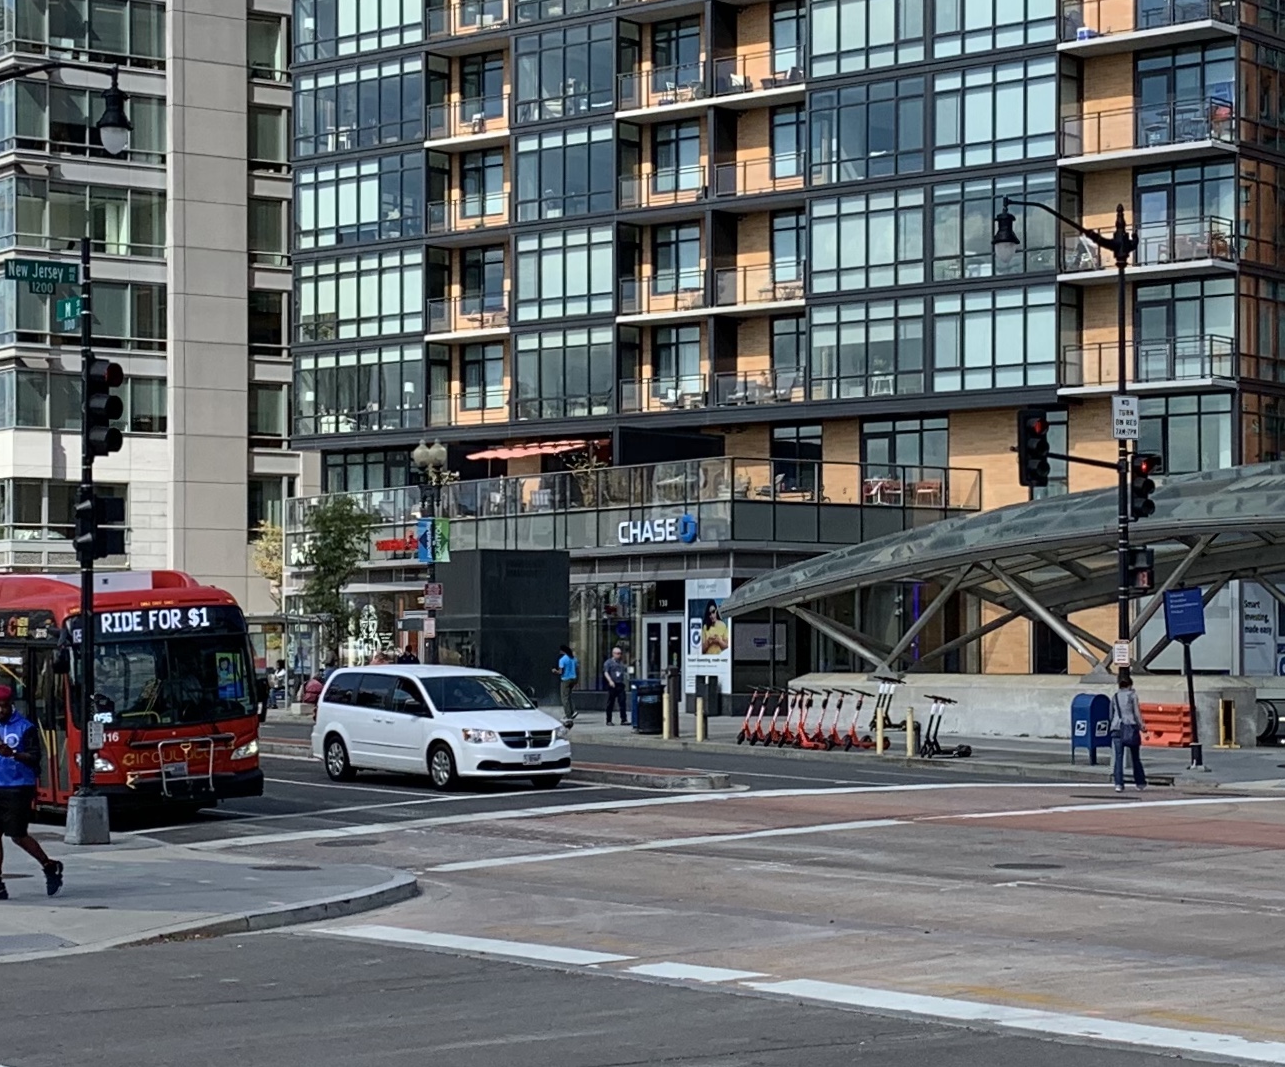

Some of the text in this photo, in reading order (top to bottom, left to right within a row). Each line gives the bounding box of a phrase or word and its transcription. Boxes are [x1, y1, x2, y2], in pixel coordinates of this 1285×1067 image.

[8, 261, 63, 283] New Jersey
[32, 281, 54, 294] 1200
[618, 518, 677, 543] CHASE
[1243, 600, 1260, 609] Smart
[101, 607, 210, 633] RIDE FOR $1
[1244, 625, 1272, 636] made easy
